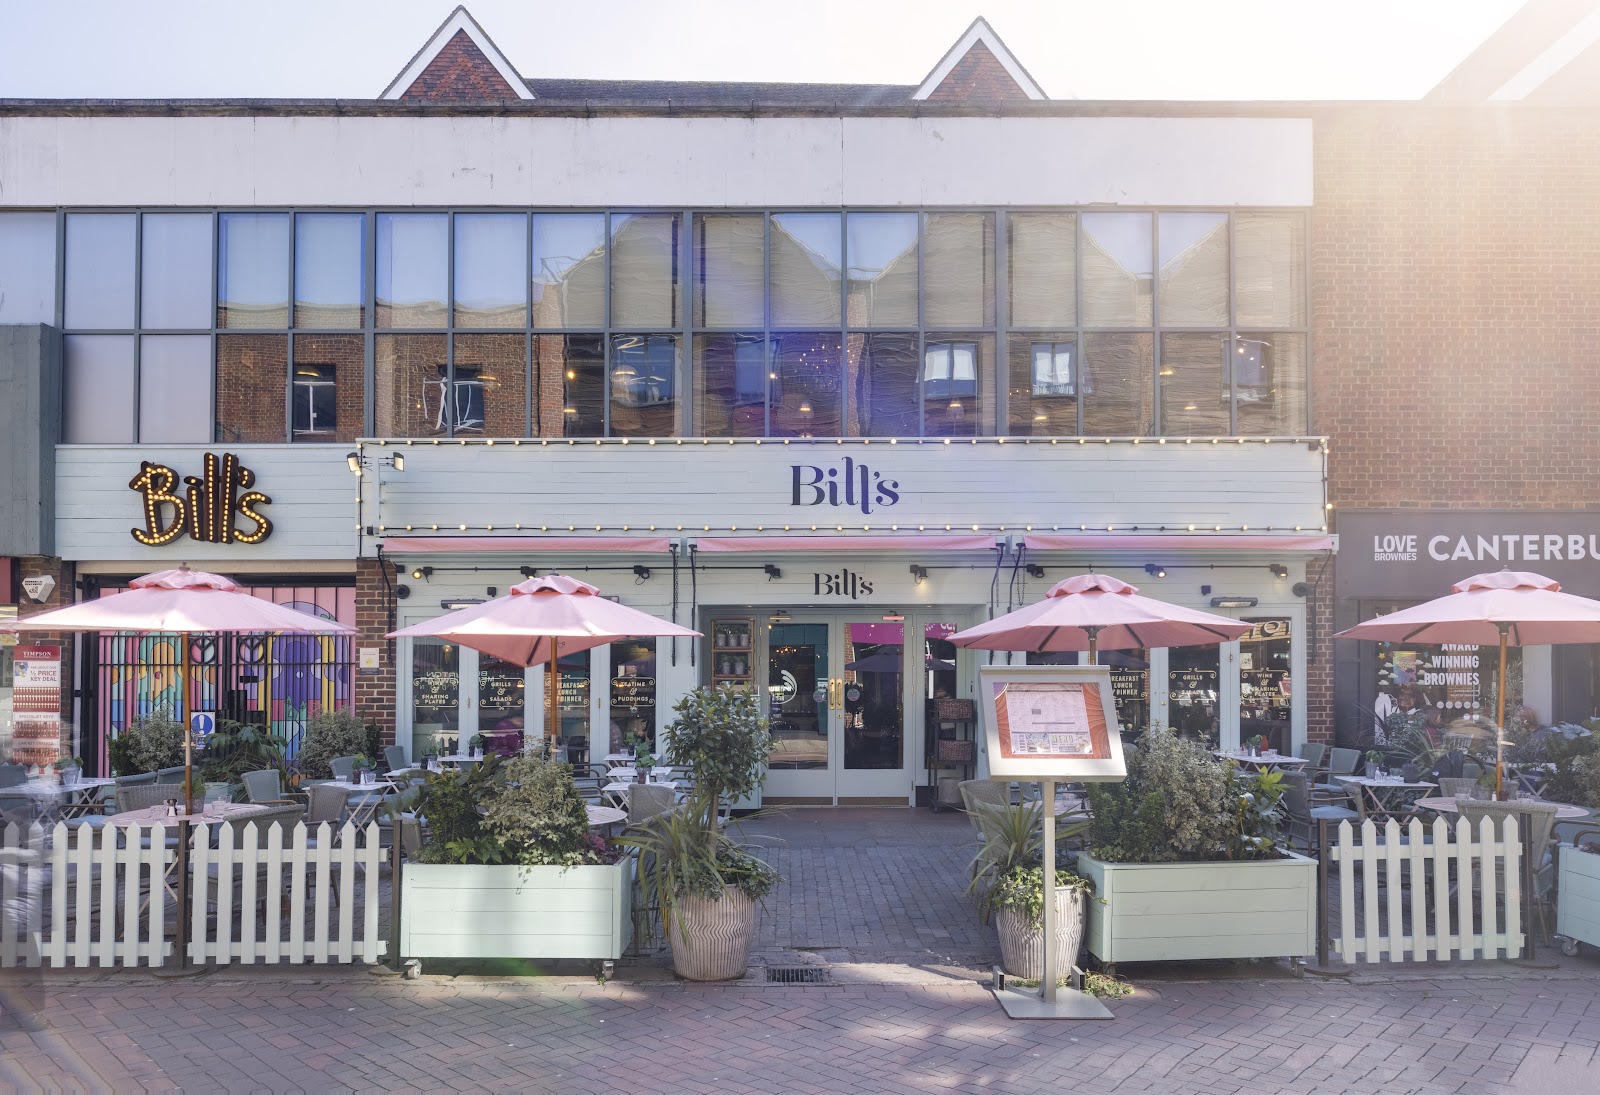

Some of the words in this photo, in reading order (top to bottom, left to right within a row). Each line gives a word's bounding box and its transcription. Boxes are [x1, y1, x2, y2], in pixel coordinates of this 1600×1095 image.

[790, 456, 900, 515] Bill's
[128, 452, 274, 546] Bill's
[1374, 535, 1417, 552] LOVE
[1374, 553, 1417, 561] BROWNIES
[813, 568, 873, 600] Bill's
[1431, 655, 1480, 668] WINNING
[1424, 672, 1480, 685] BROWNIES
